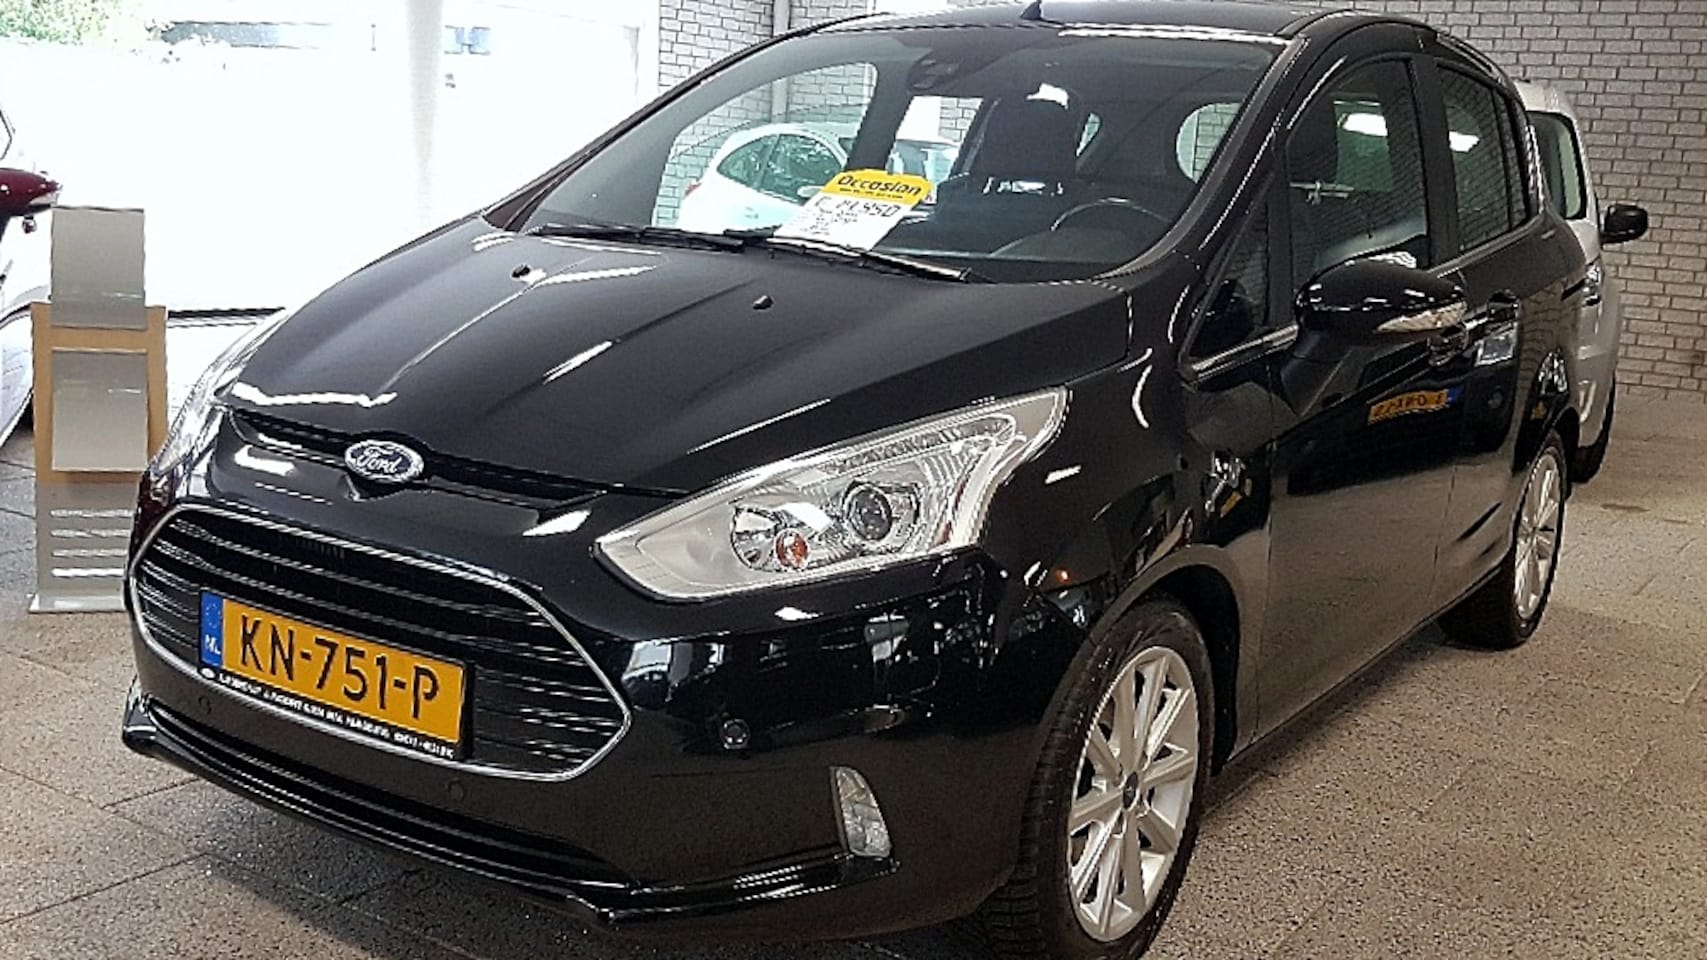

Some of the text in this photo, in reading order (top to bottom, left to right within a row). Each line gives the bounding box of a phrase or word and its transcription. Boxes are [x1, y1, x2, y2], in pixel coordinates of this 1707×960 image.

[837, 175, 922, 196] Occasion
[356, 445, 403, 473] Ford
[204, 633, 222, 656] NL
[240, 614, 440, 719] KN-751-P
